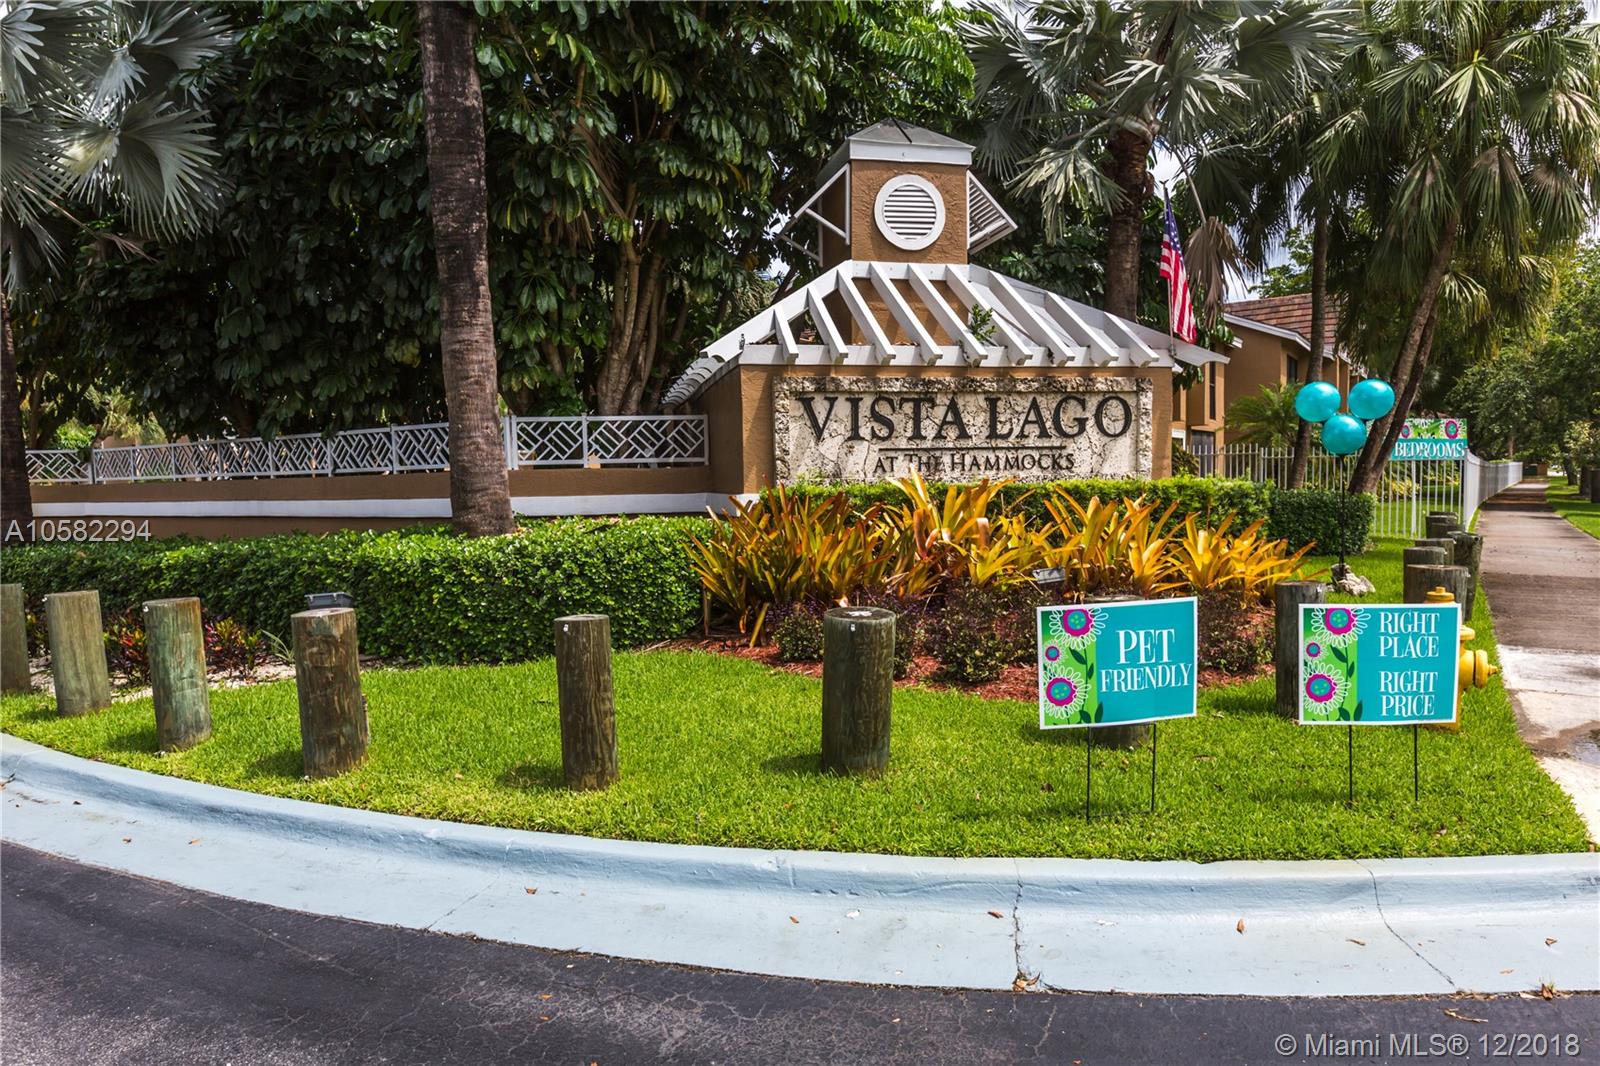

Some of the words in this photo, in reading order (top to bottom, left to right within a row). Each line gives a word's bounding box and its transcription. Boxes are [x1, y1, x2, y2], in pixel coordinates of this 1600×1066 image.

[797, 395, 970, 442] VISTA
[987, 395, 1133, 439] LAGO
[1394, 441, 1465, 458] BEDROOMS
[873, 456, 899, 474] AT
[950, 453, 1075, 472] HAMMOCKS
[1378, 610, 1440, 635] RIGHT
[1116, 628, 1176, 665] PET
[1378, 634, 1439, 659] PLACE
[1100, 663, 1193, 693] FRIENDLY
[1378, 669, 1439, 694] RIGHT
[1380, 694, 1436, 718] PRICE
